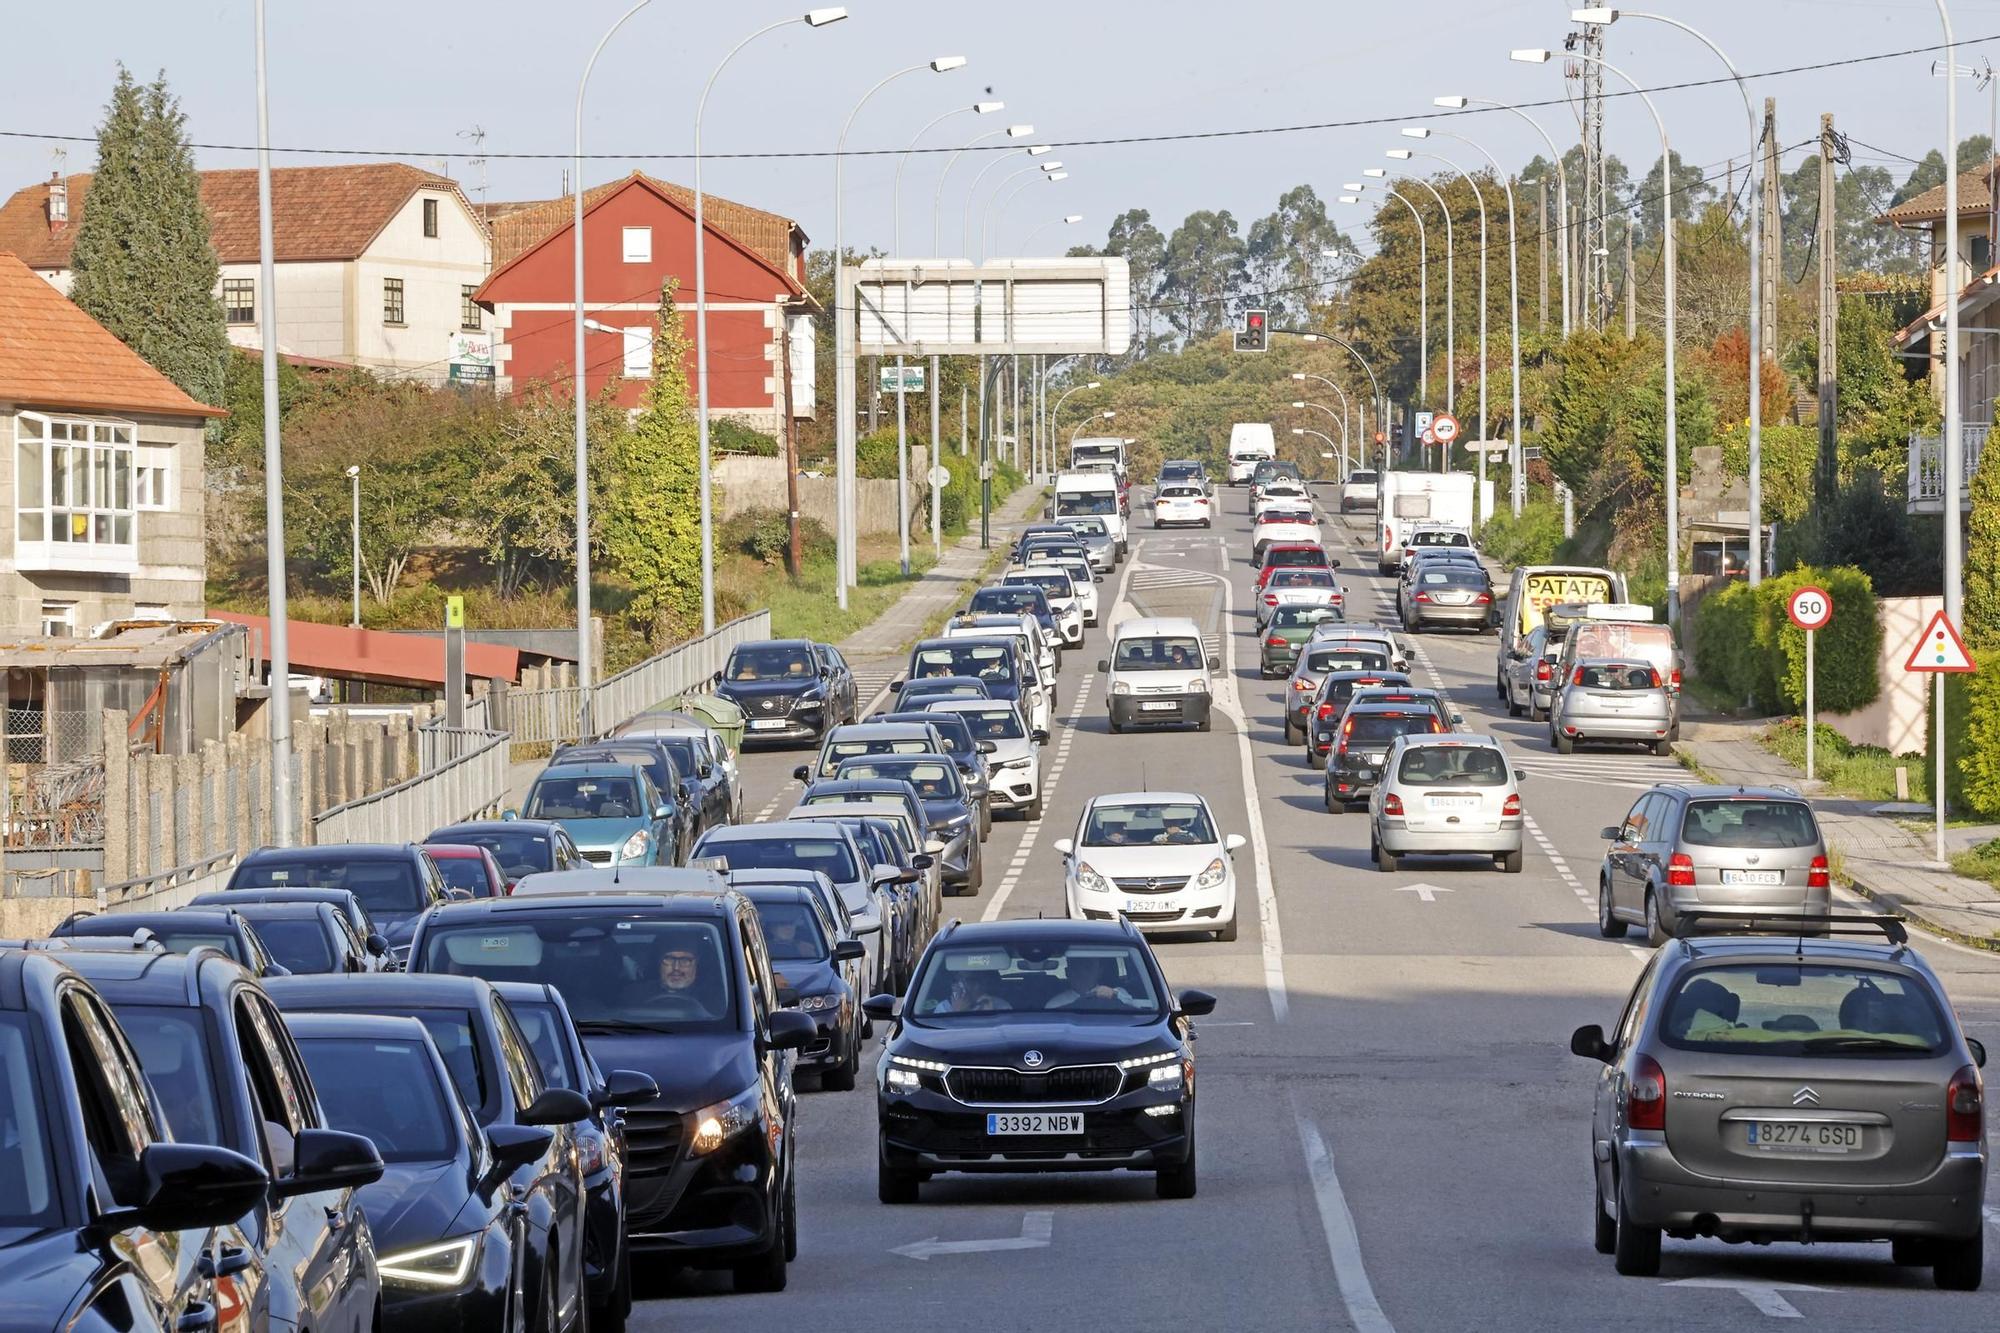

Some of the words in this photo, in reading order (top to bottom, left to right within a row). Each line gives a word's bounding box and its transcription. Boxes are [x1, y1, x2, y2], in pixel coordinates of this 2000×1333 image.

[1528, 579, 1607, 596] PATATA
[1799, 601, 1822, 615] 50
[999, 1116, 1042, 1132] 3392
[1048, 1116, 1080, 1132] NBW
[1761, 1124, 1812, 1144] 8274
[1818, 1126, 1857, 1146] GSD
